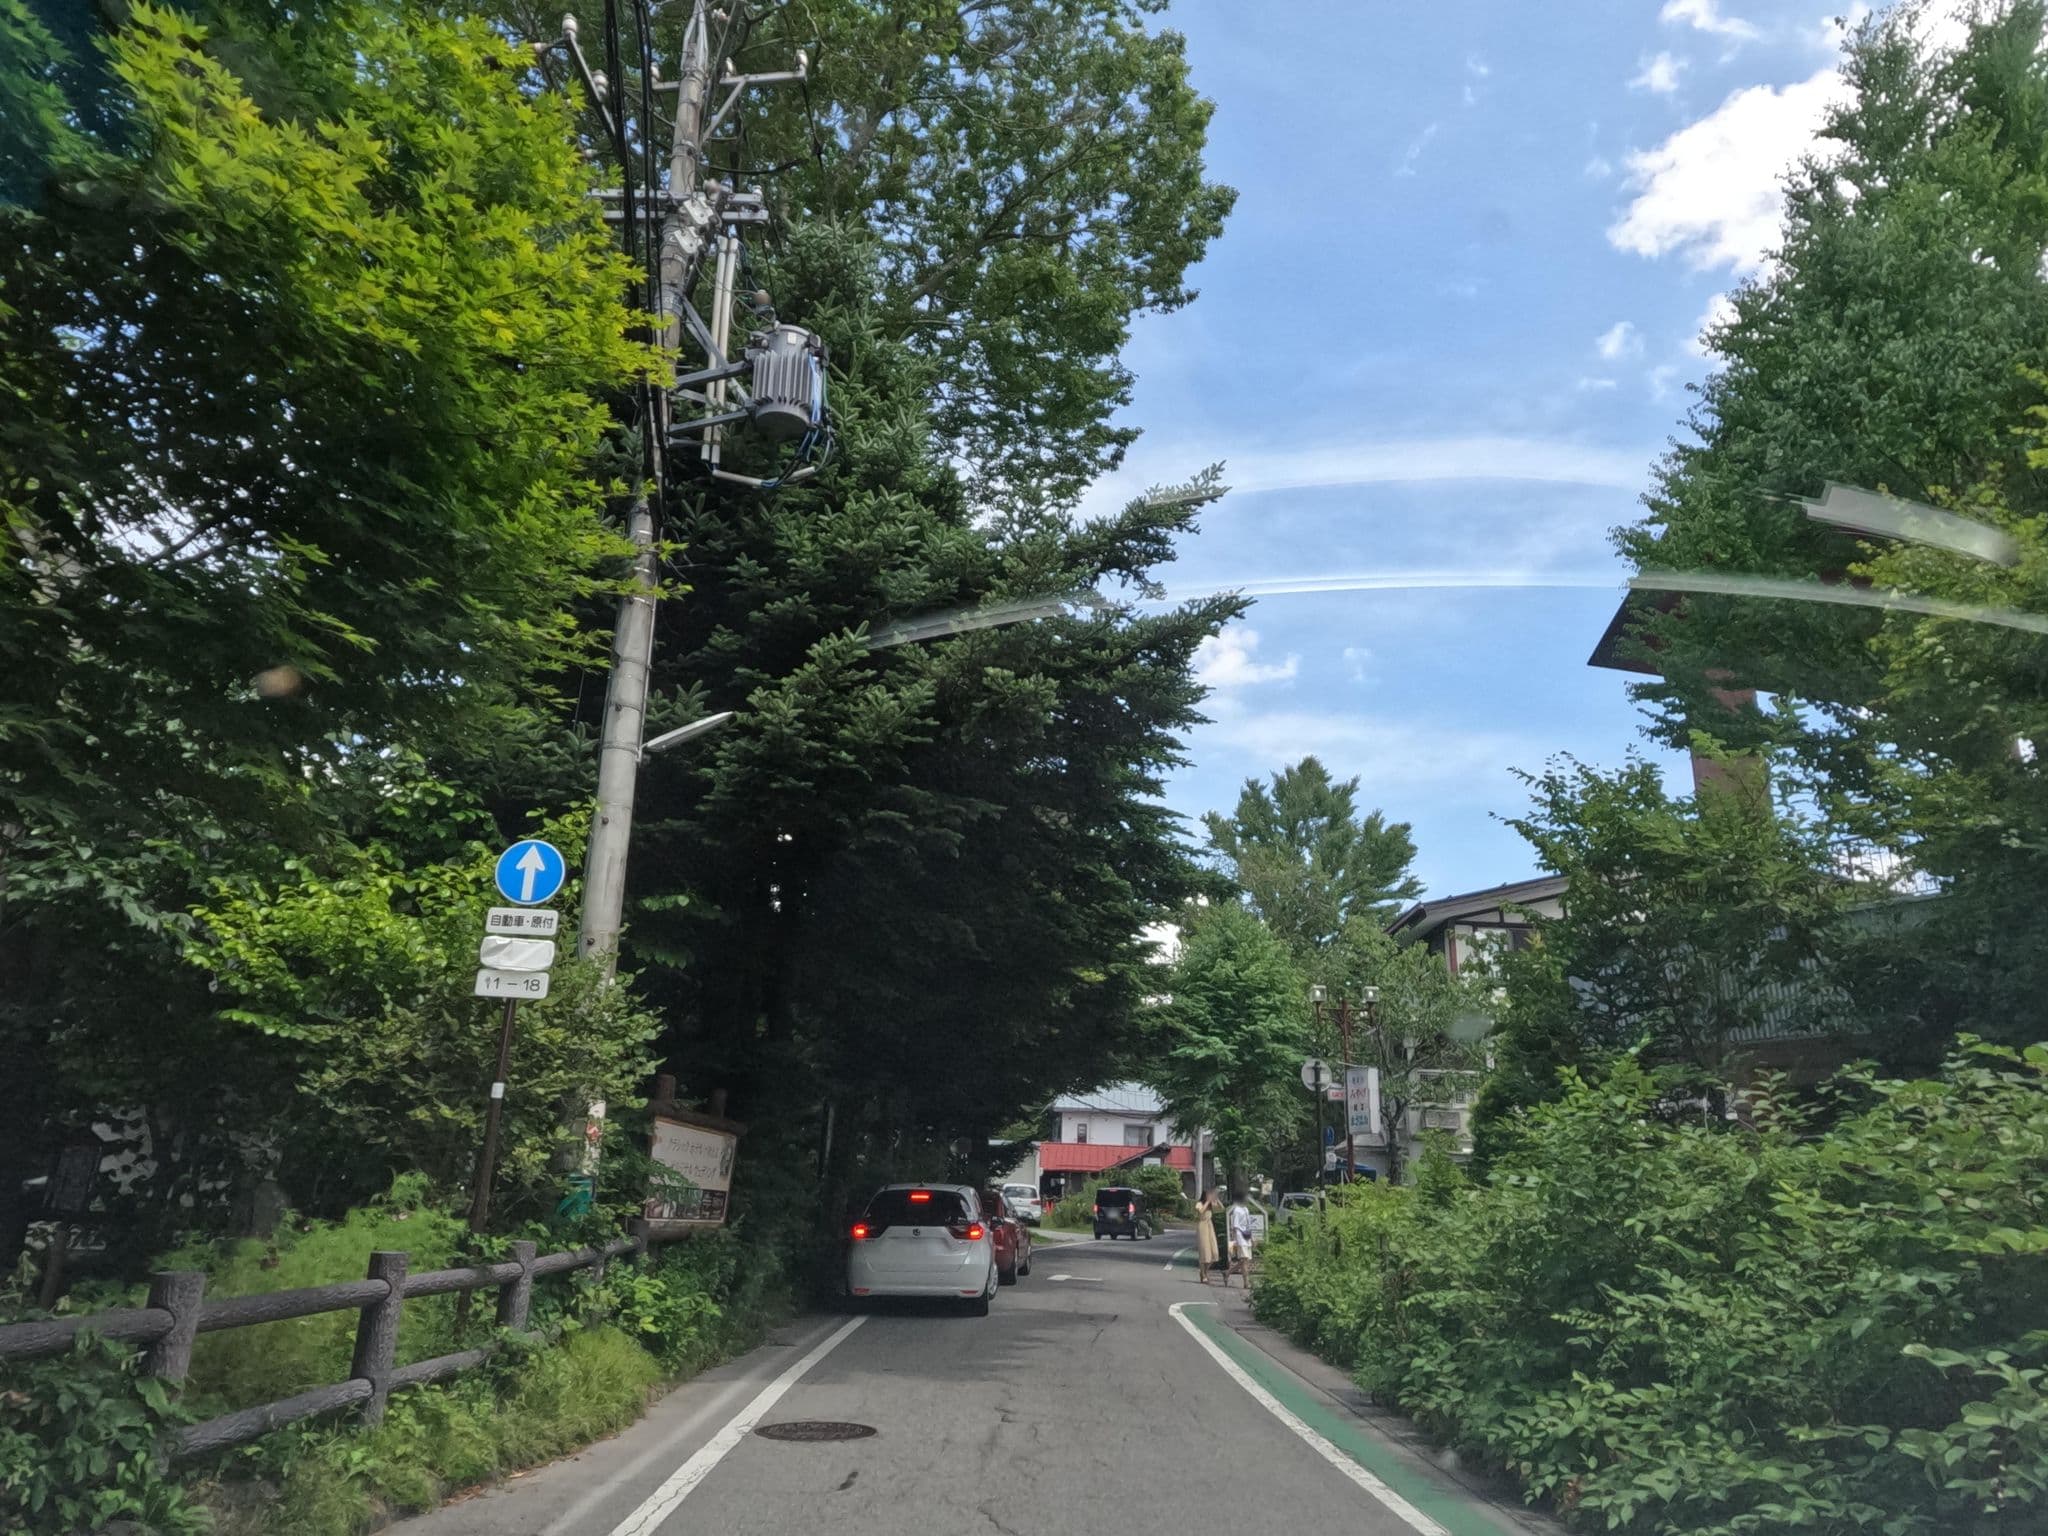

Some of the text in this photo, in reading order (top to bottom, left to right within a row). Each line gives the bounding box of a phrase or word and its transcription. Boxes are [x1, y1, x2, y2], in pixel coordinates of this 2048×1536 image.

[490, 914, 554, 929] 自動車・原付
